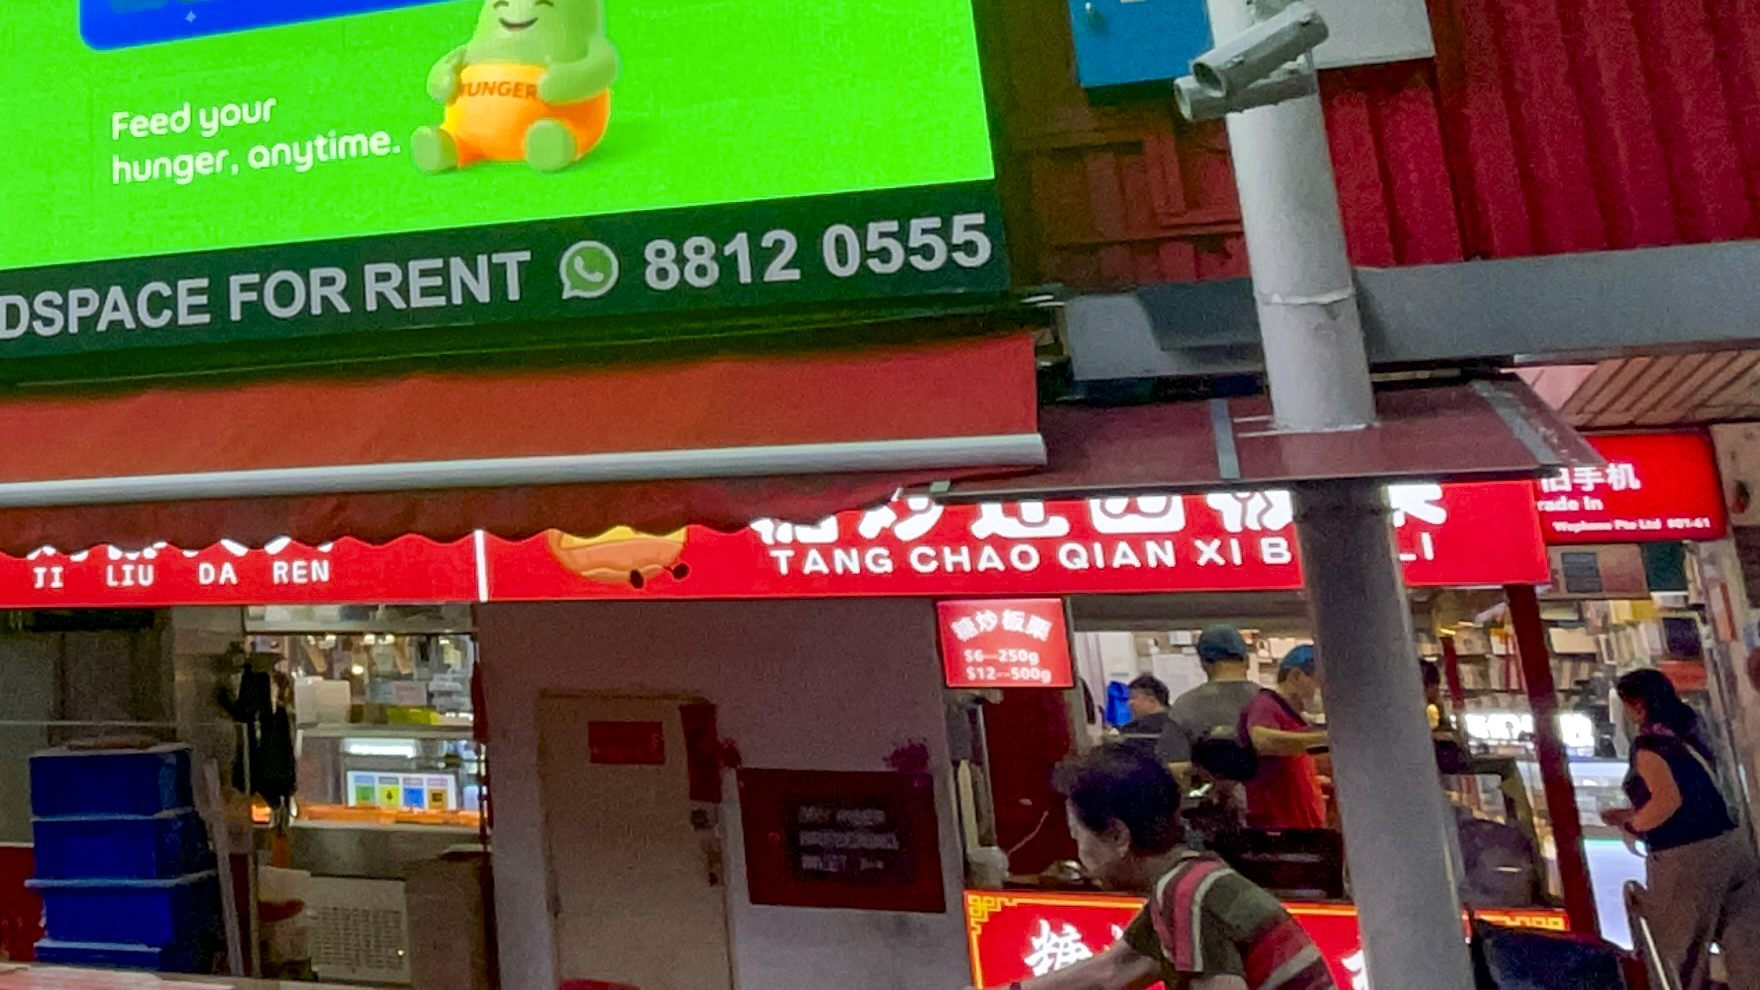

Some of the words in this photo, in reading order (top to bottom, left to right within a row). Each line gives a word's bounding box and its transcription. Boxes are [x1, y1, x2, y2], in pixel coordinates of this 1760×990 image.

[112, 103, 190, 140] Feed
[199, 98, 277, 137] your
[112, 149, 239, 185] hunger,
[247, 130, 401, 173] anytime.
[229, 267, 351, 320] FOR
[364, 251, 531, 311] RENT
[644, 229, 802, 291] 8812
[821, 213, 992, 277] 0555
[1537, 496, 1579, 511] rade
[107, 564, 154, 587] LIU
[198, 562, 239, 586] DA
[273, 559, 331, 585] REN
[769, 546, 894, 575] TANG
[909, 543, 1040, 573] CHAO
[1058, 537, 1176, 570] QIAN
[1195, 537, 1242, 567] XI
